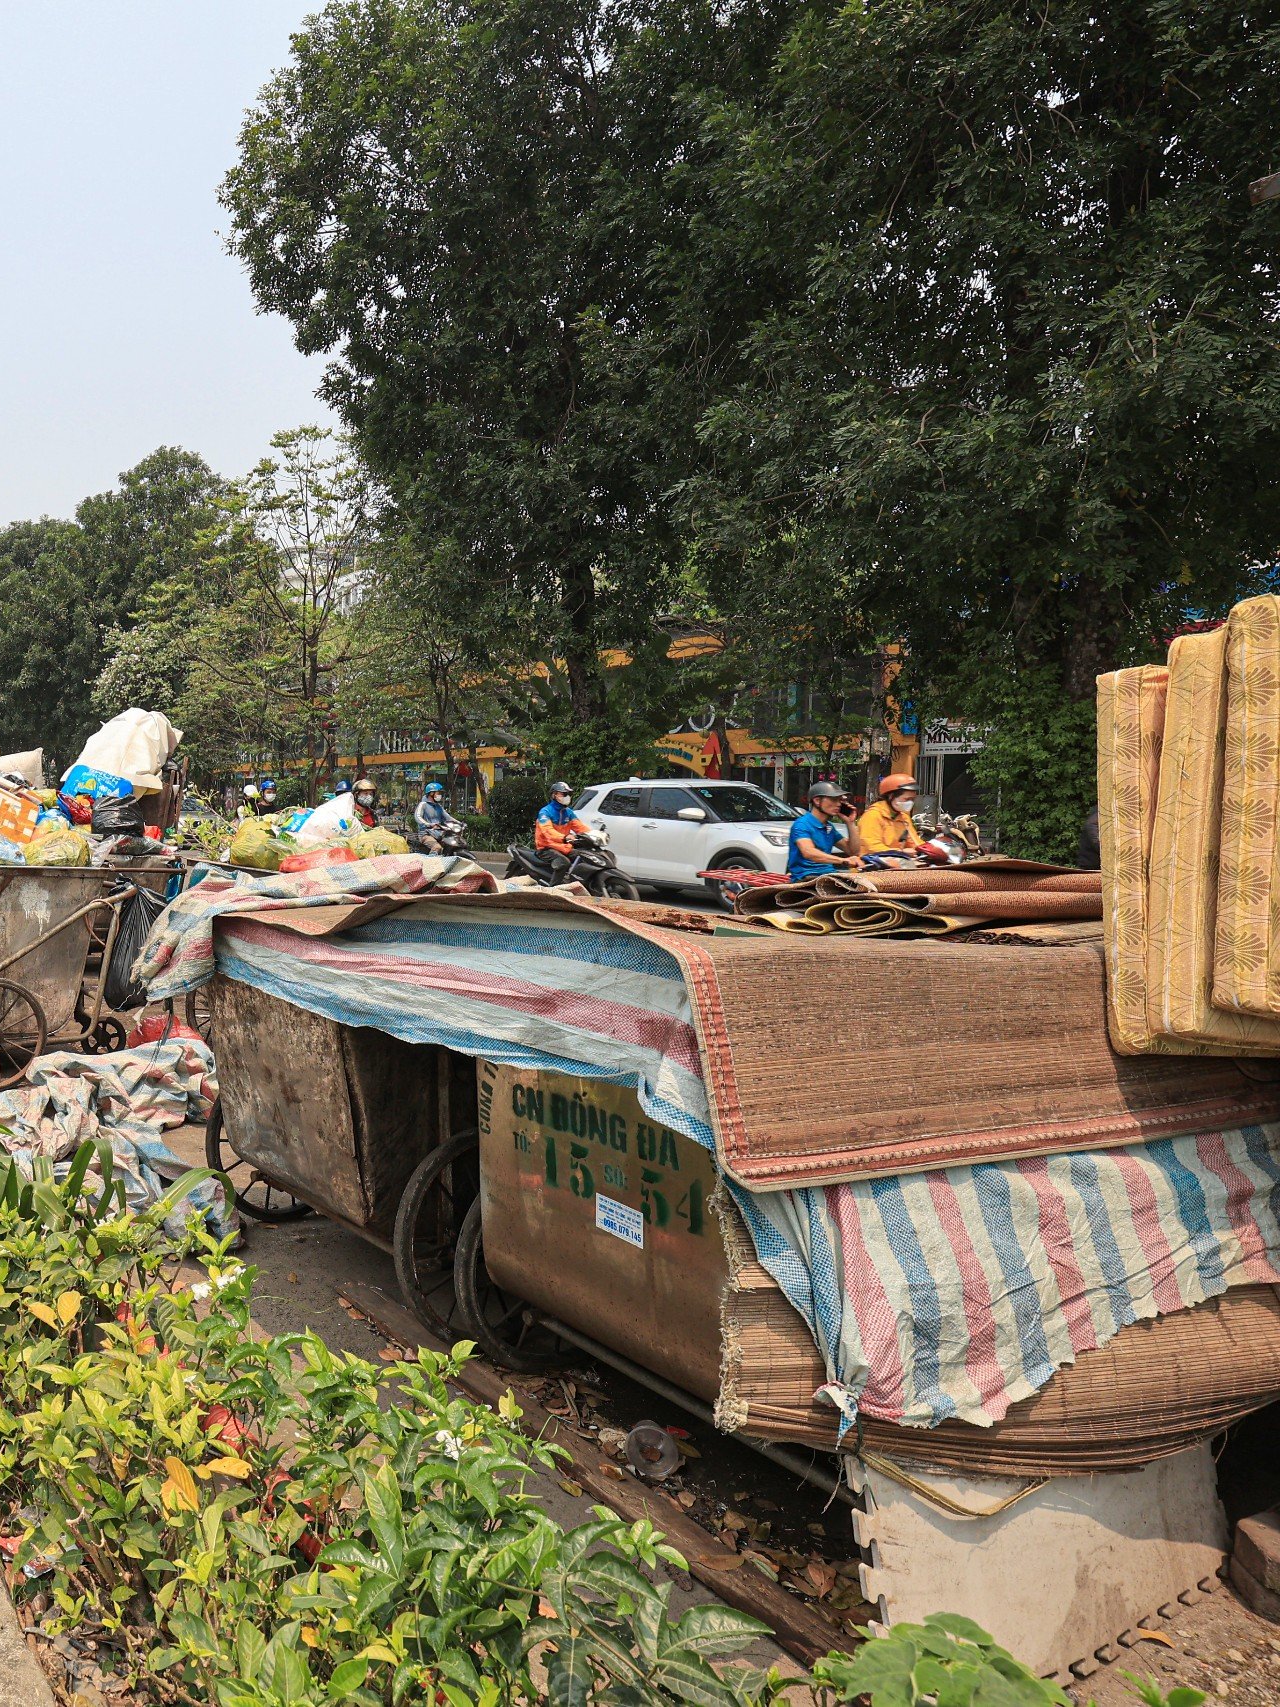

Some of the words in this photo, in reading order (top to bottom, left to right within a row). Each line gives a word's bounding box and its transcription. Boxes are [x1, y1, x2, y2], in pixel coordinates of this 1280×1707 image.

[512, 1083, 545, 1125] CN
[637, 1122, 680, 1171] ĐA
[545, 1135, 596, 1199] 15
[641, 1166, 704, 1236] 54
